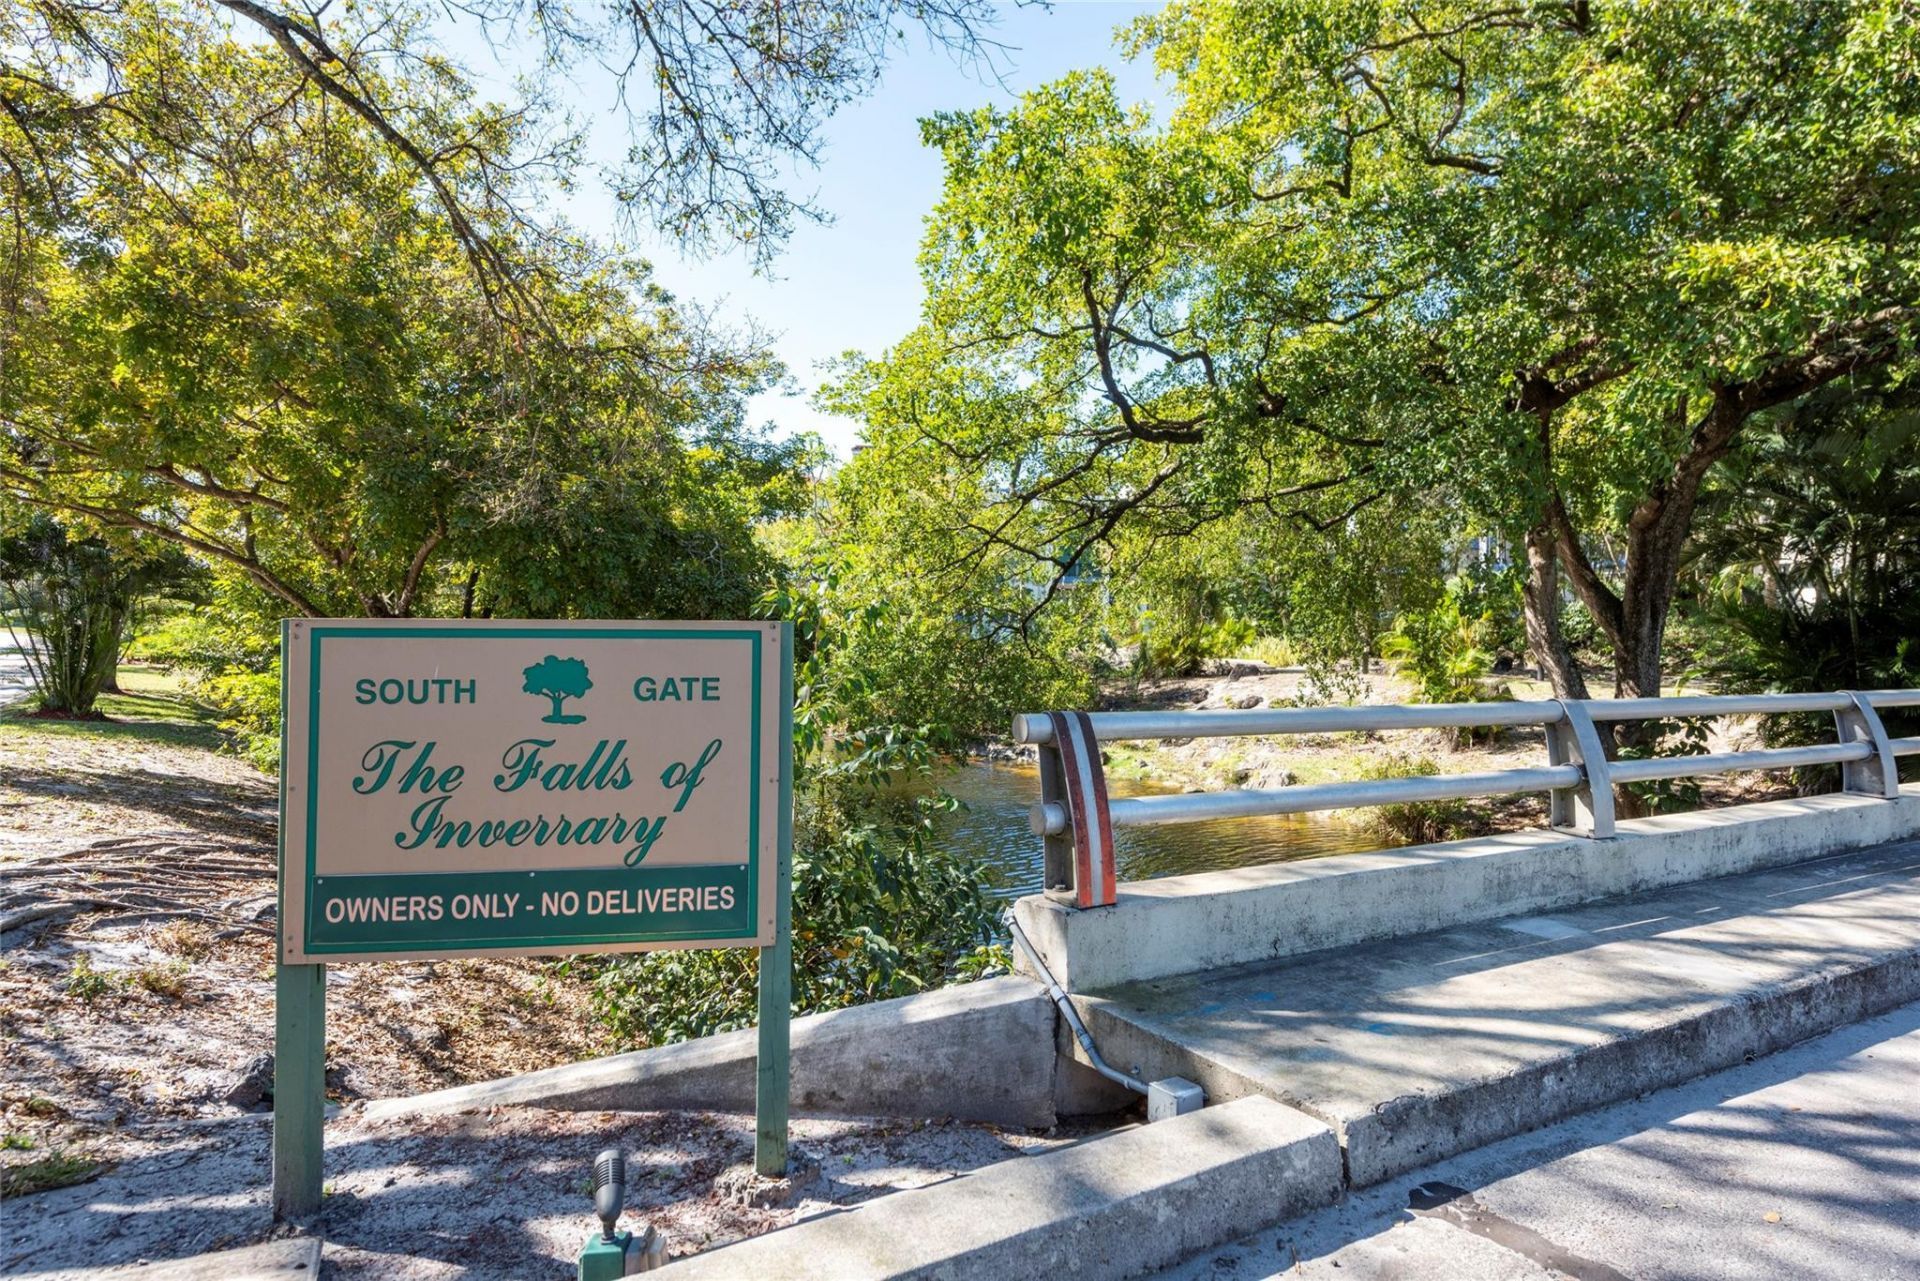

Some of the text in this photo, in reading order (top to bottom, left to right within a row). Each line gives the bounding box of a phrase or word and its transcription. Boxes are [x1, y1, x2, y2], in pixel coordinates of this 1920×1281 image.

[355, 676, 721, 704] SOUTH GATE
[351, 738, 723, 812] The Falls of
[394, 795, 668, 867] Inverrary
[325, 896, 444, 924] OWNERS
[451, 893, 521, 919] ONLY
[541, 891, 580, 917] NO
[586, 886, 735, 915] DELIVERIES
